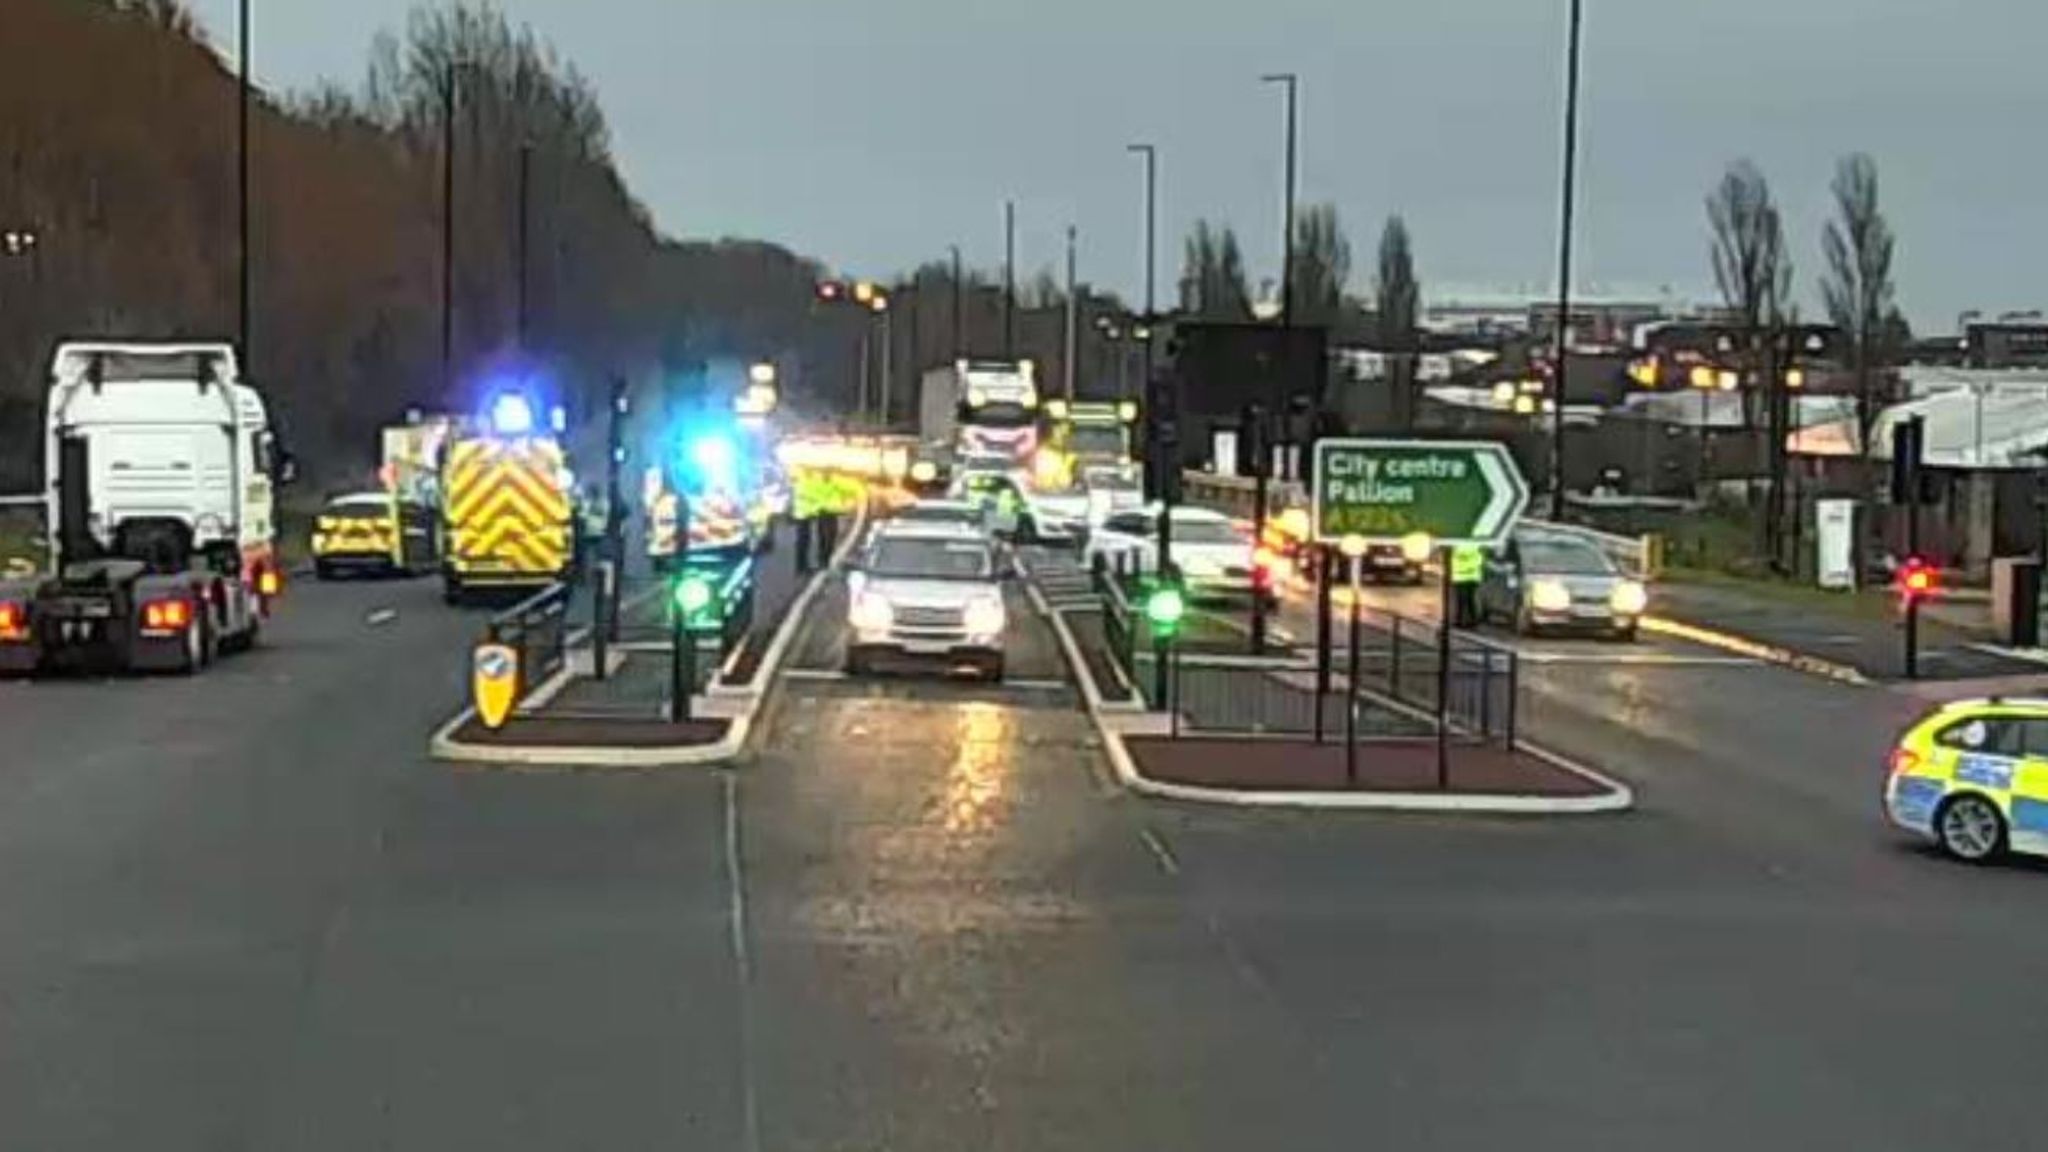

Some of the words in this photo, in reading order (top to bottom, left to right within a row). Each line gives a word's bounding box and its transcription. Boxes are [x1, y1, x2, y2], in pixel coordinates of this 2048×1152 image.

[1328, 452, 1378, 482] City
[1386, 456, 1466, 477] centre
[1328, 481, 1414, 503] Pallion
